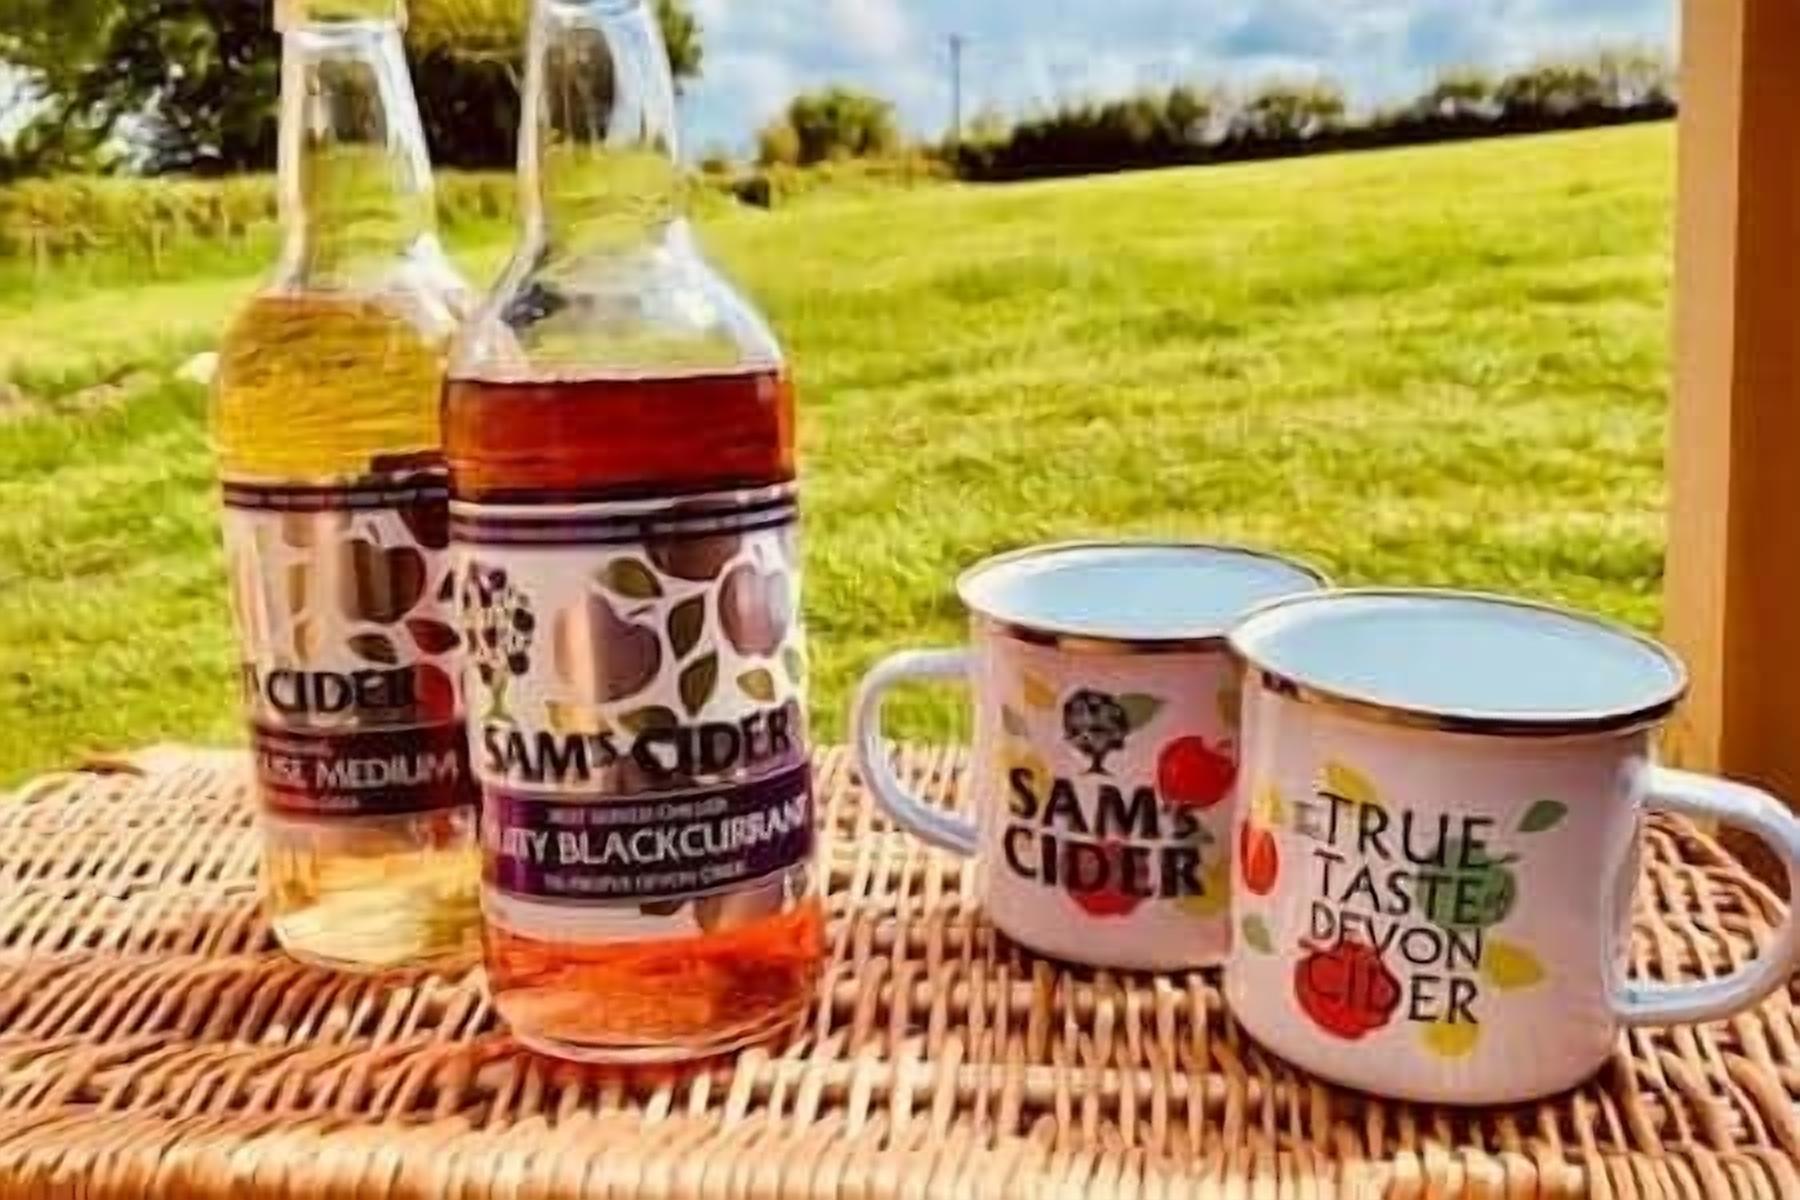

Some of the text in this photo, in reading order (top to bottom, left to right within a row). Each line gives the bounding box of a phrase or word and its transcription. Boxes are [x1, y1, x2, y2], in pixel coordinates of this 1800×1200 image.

[315, 750, 460, 790] MEDIUM
[632, 707, 791, 777] CIDER
[1004, 824, 1206, 898] CIDER
[1317, 791, 1494, 869] TRUE
[1313, 849, 1487, 925] TASTE
[1311, 901, 1481, 970] DEVON
